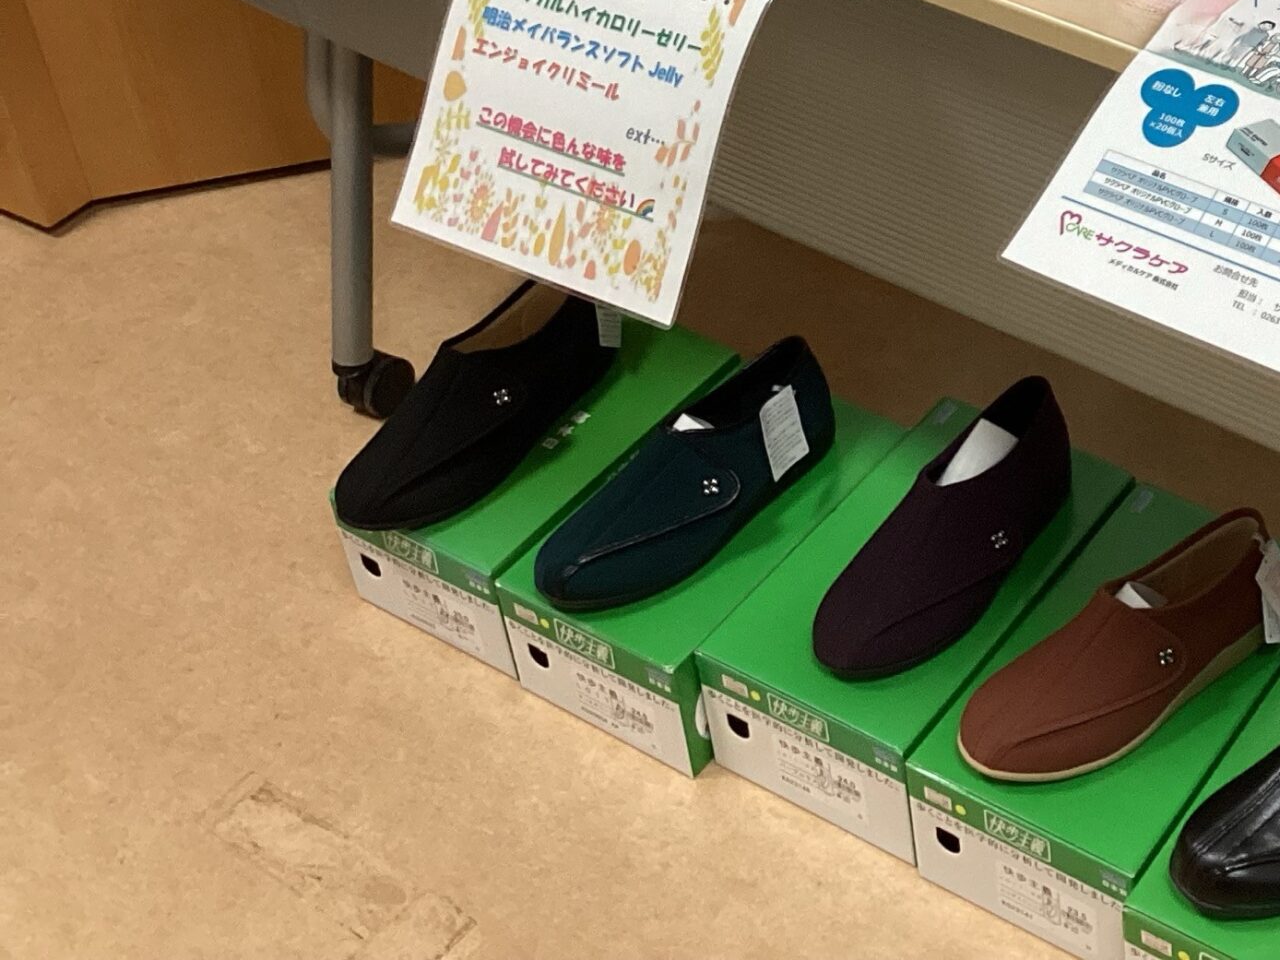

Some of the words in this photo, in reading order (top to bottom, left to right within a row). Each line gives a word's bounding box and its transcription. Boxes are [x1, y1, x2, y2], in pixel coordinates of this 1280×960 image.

[471, 36, 621, 102] エンジョイクリミール
[648, 59, 685, 88] Jelly
[1152, 81, 1181, 97] 粉なし
[1196, 103, 1220, 116] 兼用
[1204, 94, 1226, 107] 左右
[1160, 113, 1186, 127] 100枚
[477, 107, 627, 172] この機会に色んな味を
[1202, 153, 1237, 171] Sサイズ
[498, 146, 638, 210] 試してみてください
[1151, 169, 1166, 180] 品名
[1104, 177, 1131, 191] サクラベア
[1241, 229, 1262, 242] 100枚
[1223, 208, 1228, 216] S
[1209, 230, 1214, 238] L
[1095, 231, 1190, 277] サクラケア
[1108, 258, 1153, 278] メディカルケア
[1212, 263, 1260, 290] お問合せ先
[1232, 300, 1245, 311] TEL
